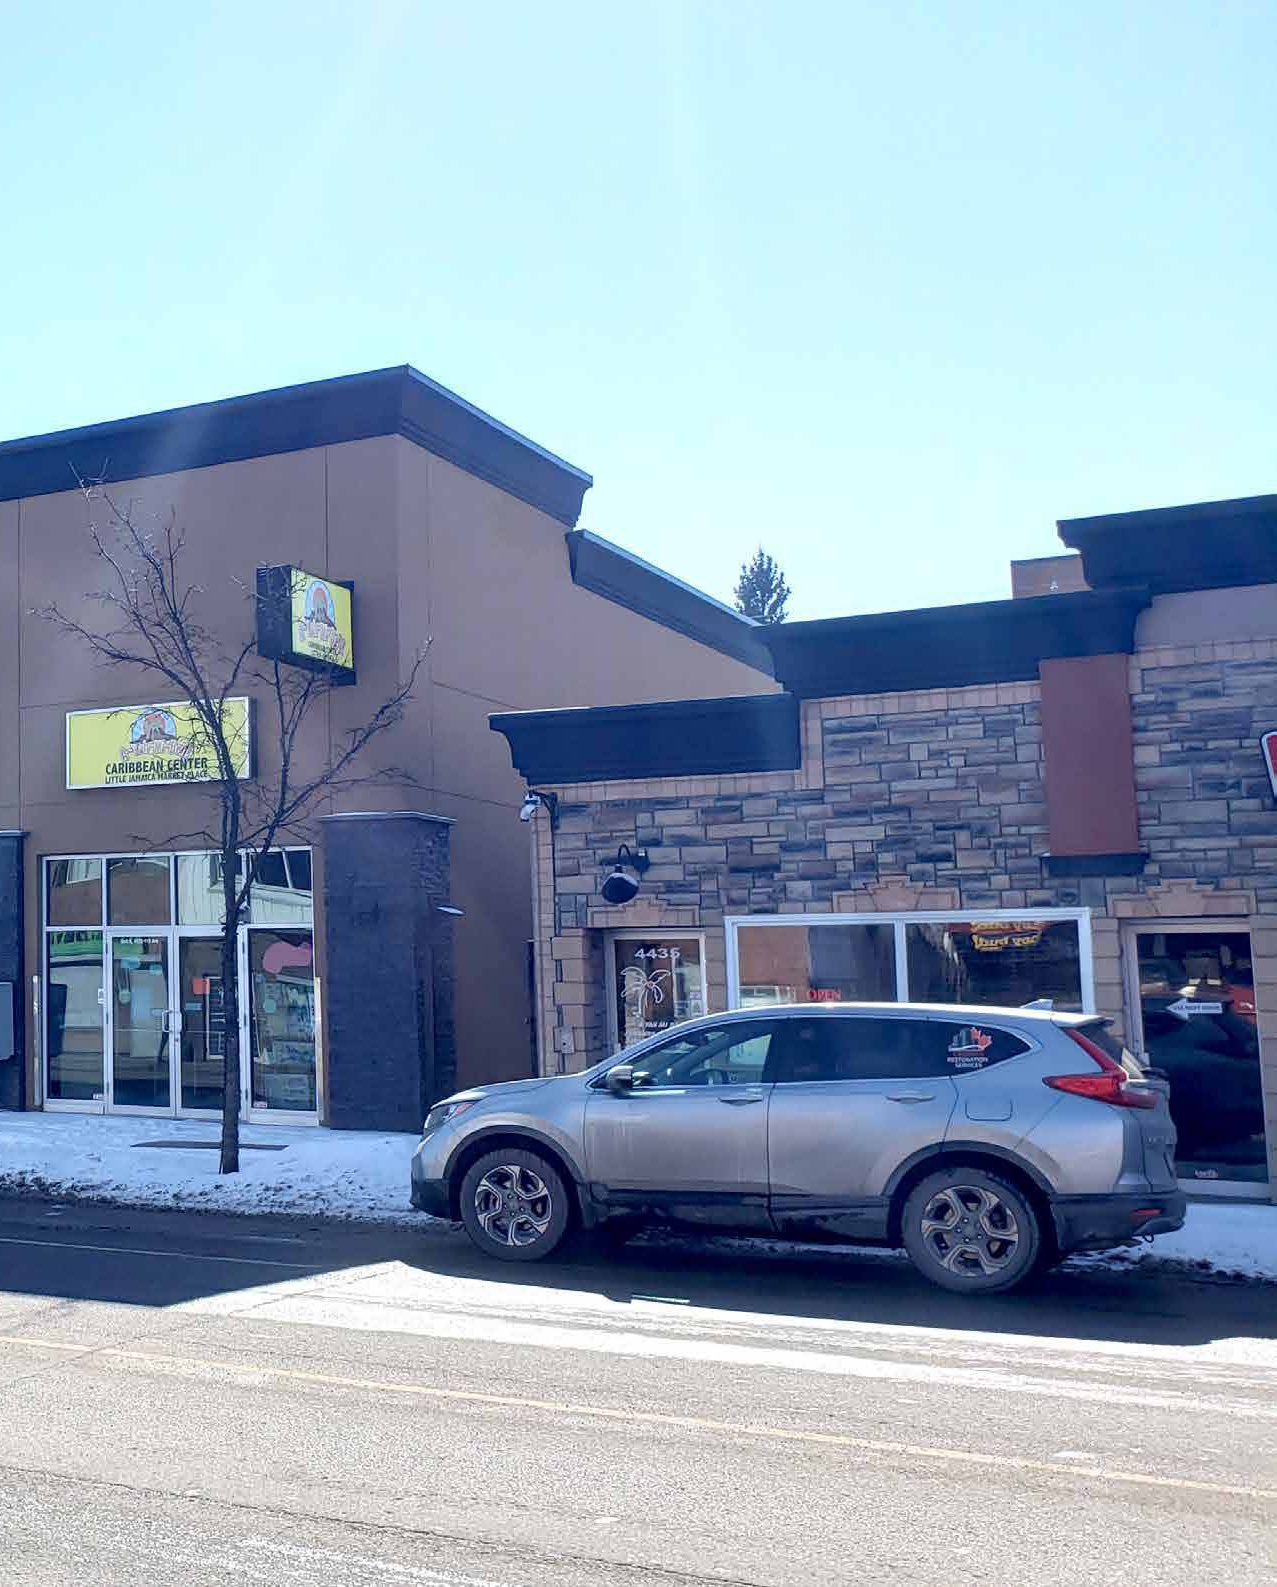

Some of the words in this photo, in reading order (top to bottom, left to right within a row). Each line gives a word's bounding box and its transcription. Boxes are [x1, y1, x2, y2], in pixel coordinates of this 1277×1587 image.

[105, 759, 164, 775] CARIBBEAN
[167, 757, 208, 771] CENTER
[105, 774, 125, 784] LITTLE
[128, 772, 156, 782] JAMAICA
[634, 947, 681, 959] 4435
[806, 989, 842, 1001] OPEN
